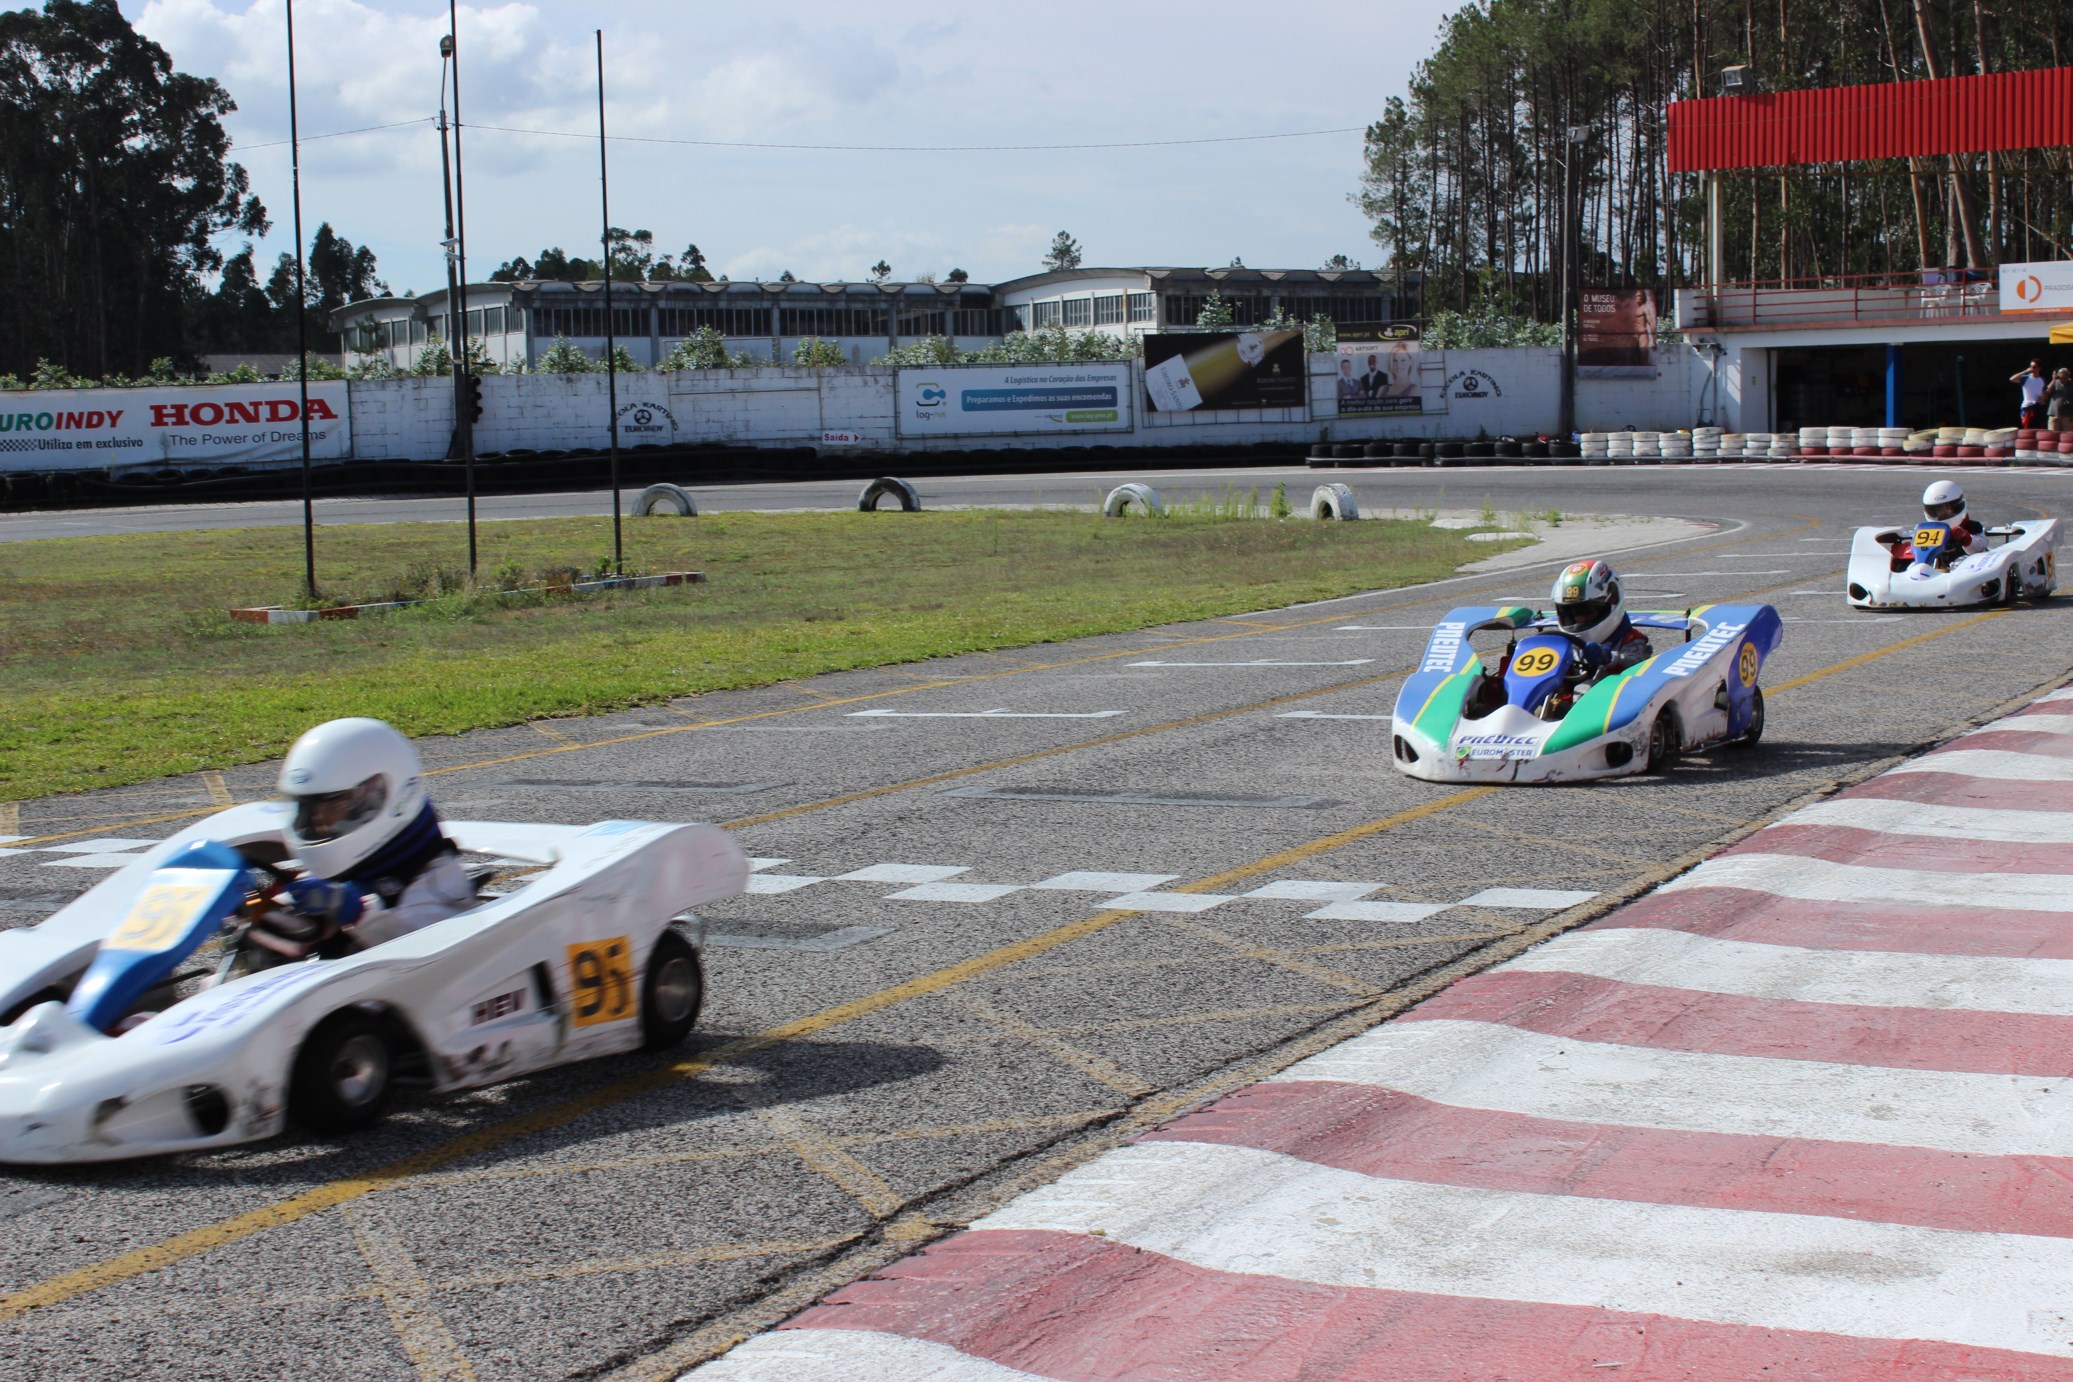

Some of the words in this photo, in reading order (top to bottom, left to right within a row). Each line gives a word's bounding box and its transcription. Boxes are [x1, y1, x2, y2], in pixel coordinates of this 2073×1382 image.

[1583, 294, 1589, 302] O
[1591, 294, 1616, 303] MUSEU
[1583, 304, 1592, 313] DE
[1593, 304, 1616, 313] TODOS
[1394, 328, 1409, 338] apri
[1087, 374, 1117, 383] Empresas
[966, 395, 1006, 405] Preparamos
[1012, 393, 1047, 404] Expedimos
[1072, 392, 1112, 401] encomendas
[150, 398, 338, 428] HONDA
[642, 402, 679, 431] KARTING
[38, 438, 73, 451] Utiliza
[76, 441, 92, 449] em
[96, 437, 144, 450] exclusivo
[169, 434, 197, 447] The
[202, 432, 249, 446] Power
[252, 431, 267, 443] of
[270, 430, 327, 443] Dreams
[1916, 529, 1941, 545] 94
[1565, 585, 1580, 598] 99
[1516, 653, 1555, 672] 99
[1739, 649, 1757, 682] 99
[1471, 749, 1533, 757] EUROMSTER
